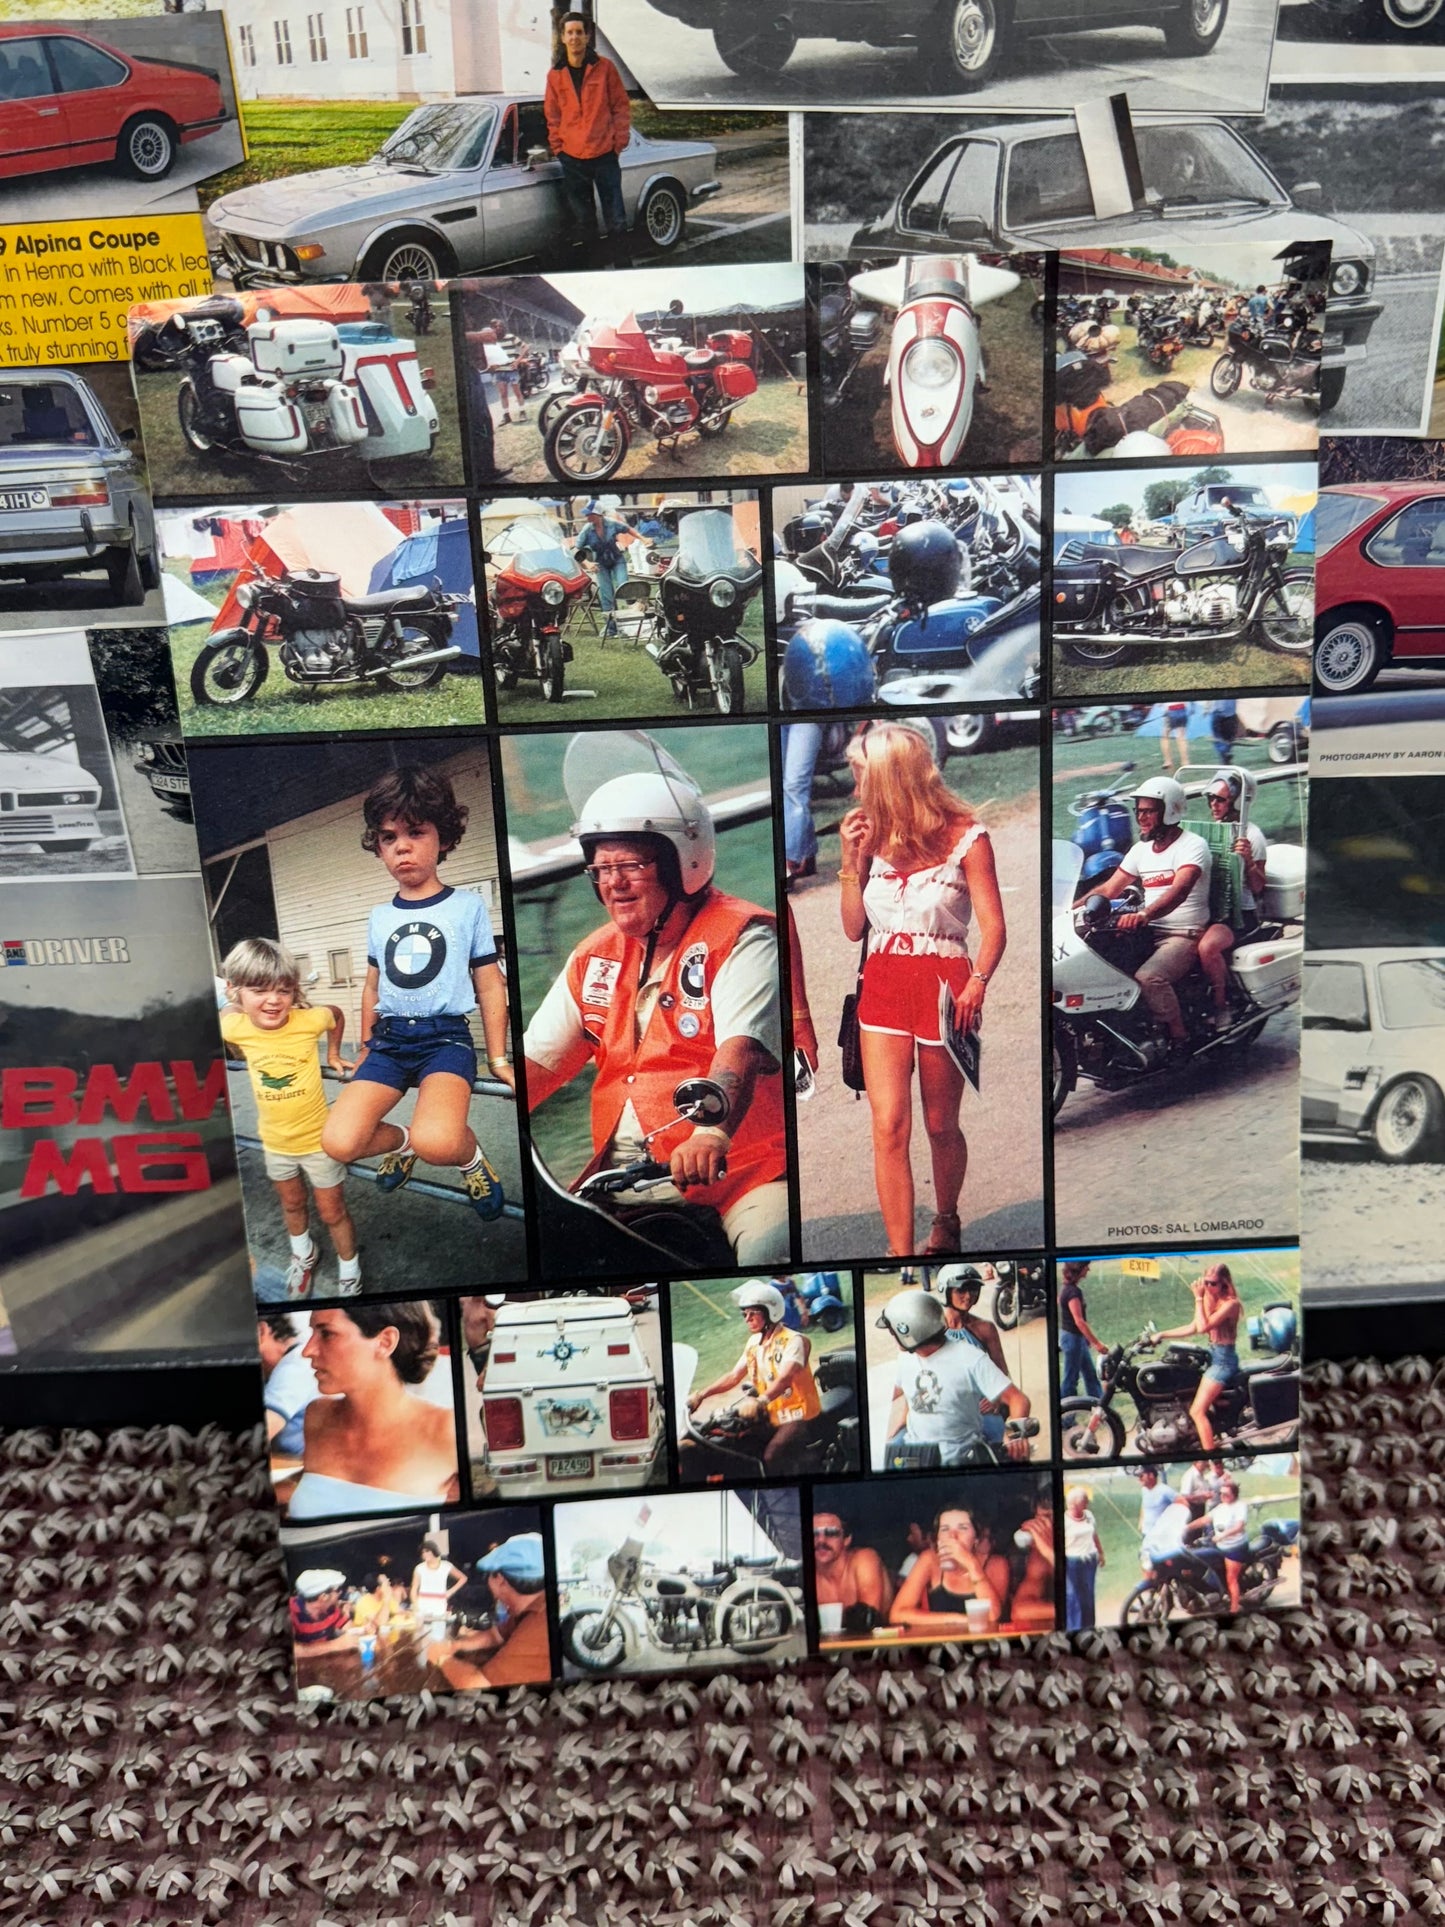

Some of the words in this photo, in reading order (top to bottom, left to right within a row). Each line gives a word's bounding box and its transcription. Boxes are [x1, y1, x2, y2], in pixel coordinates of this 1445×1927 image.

[16, 234, 82, 257] Alpina
[89, 231, 160, 251] Coupe
[4, 264, 21, 282] in
[25, 262, 84, 280] Henna
[89, 257, 124, 276] with
[128, 254, 176, 274] Black
[180, 253, 209, 271] lea
[21, 292, 63, 308] new.
[69, 286, 133, 306] Comes
[138, 281, 172, 300] with
[179, 279, 198, 297] all
[22, 314, 93, 334] Number
[100, 311, 111, 329] 5
[7, 342, 40, 364] truly
[47, 338, 118, 359] stunning
[1320, 752, 1391, 762] PHOTOGRAPHY
[1392, 751, 1406, 760] BY
[1408, 750, 1441, 759] AARON
[6, 948, 26, 959] AND
[25, 936, 131, 966] DRIVER
[20, 1132, 211, 1198] M6
[1108, 1224, 1163, 1237] PHOTOS:
[1166, 1223, 1190, 1234] SAL
[1194, 1219, 1264, 1233] LOMBARDO
[1129, 1260, 1151, 1272] EXIT
